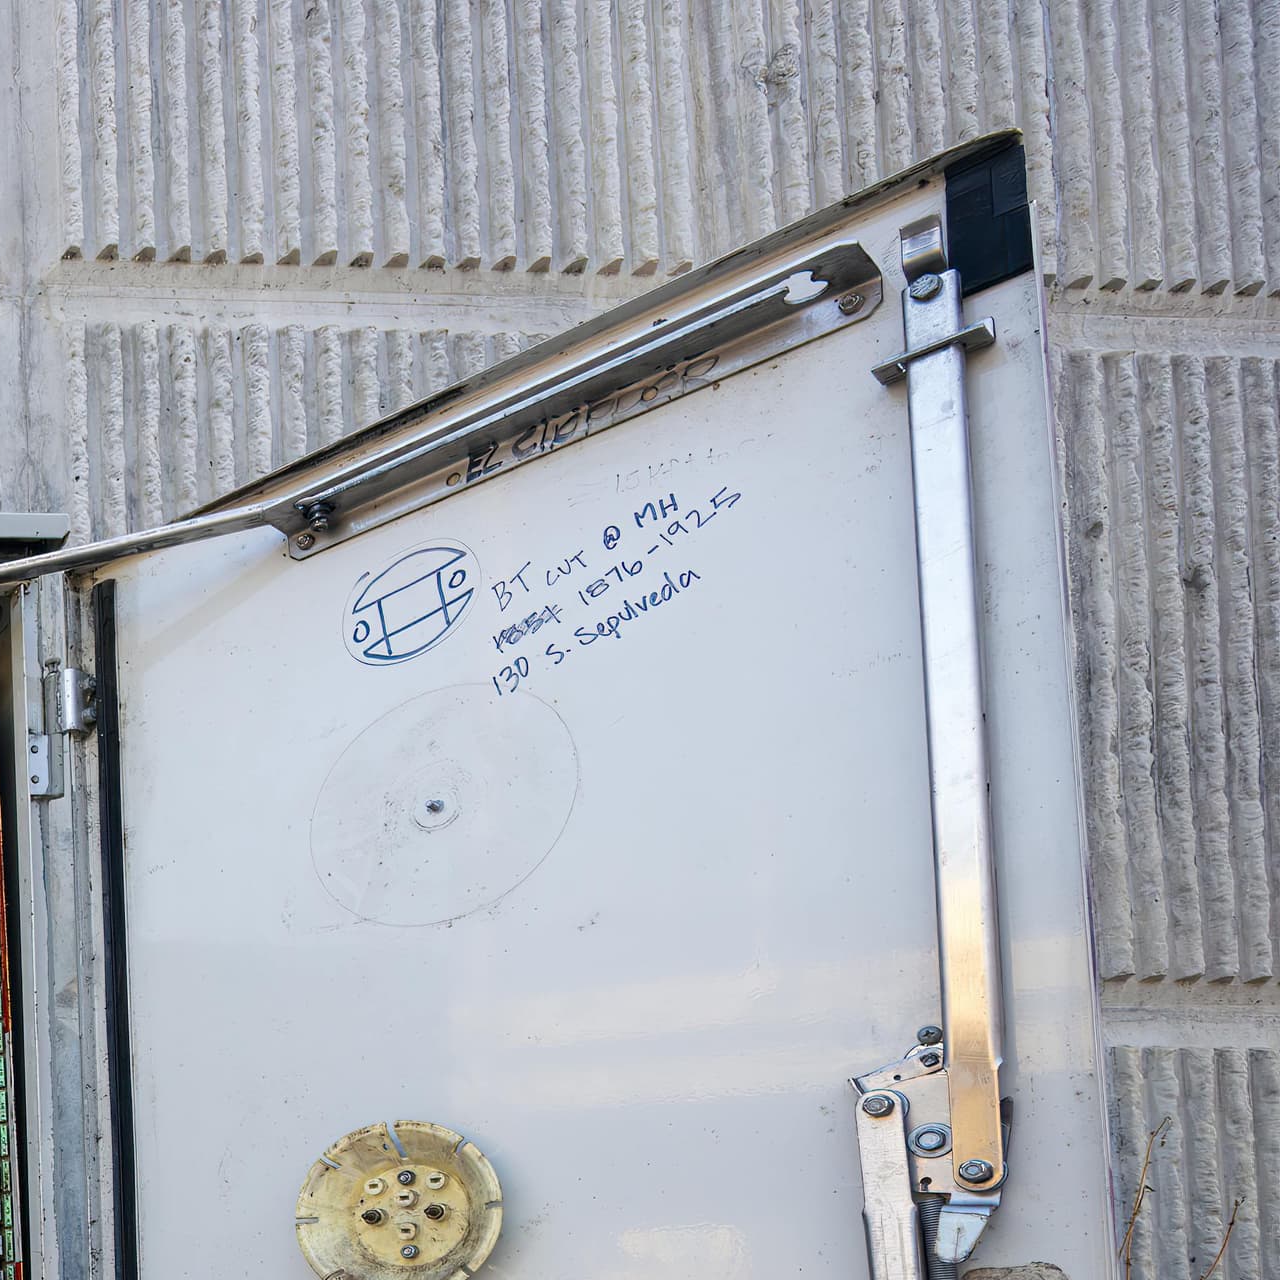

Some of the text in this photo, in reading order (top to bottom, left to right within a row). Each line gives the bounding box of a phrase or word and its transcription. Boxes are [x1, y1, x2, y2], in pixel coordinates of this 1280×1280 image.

[491, 561, 531, 612] BT
[546, 550, 587, 586] CUT
[634, 493, 679, 529] MH
[493, 656, 529, 696] 130
[574, 569, 701, 646] Sepulveda
